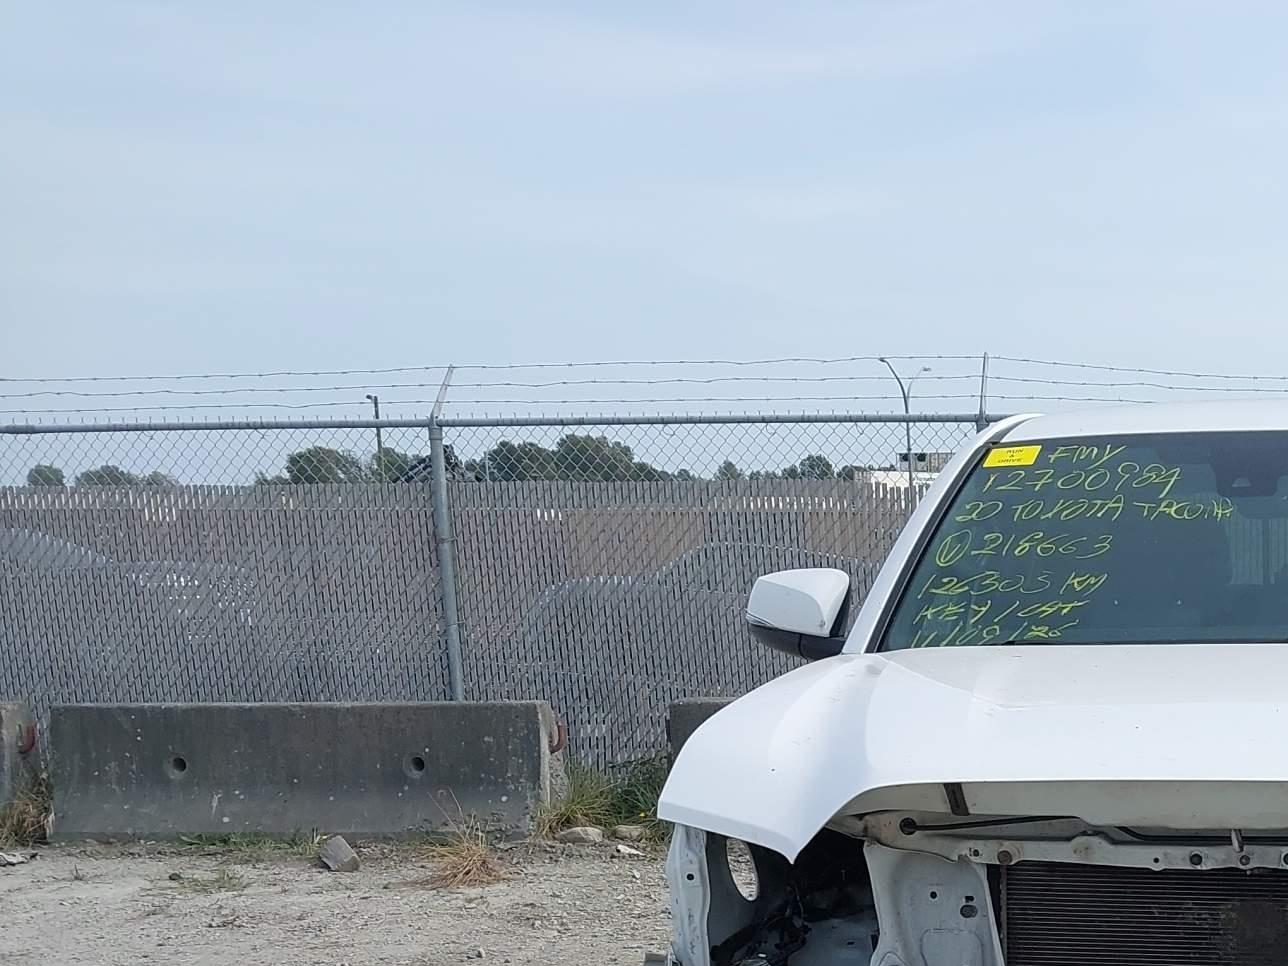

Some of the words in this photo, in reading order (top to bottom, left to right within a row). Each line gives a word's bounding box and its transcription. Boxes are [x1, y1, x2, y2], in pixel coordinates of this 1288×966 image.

[983, 462, 1181, 499] 12700984
[955, 501, 1003, 522] 20
[1012, 495, 1124, 522] TOYOTA
[971, 532, 1113, 559] 218663
